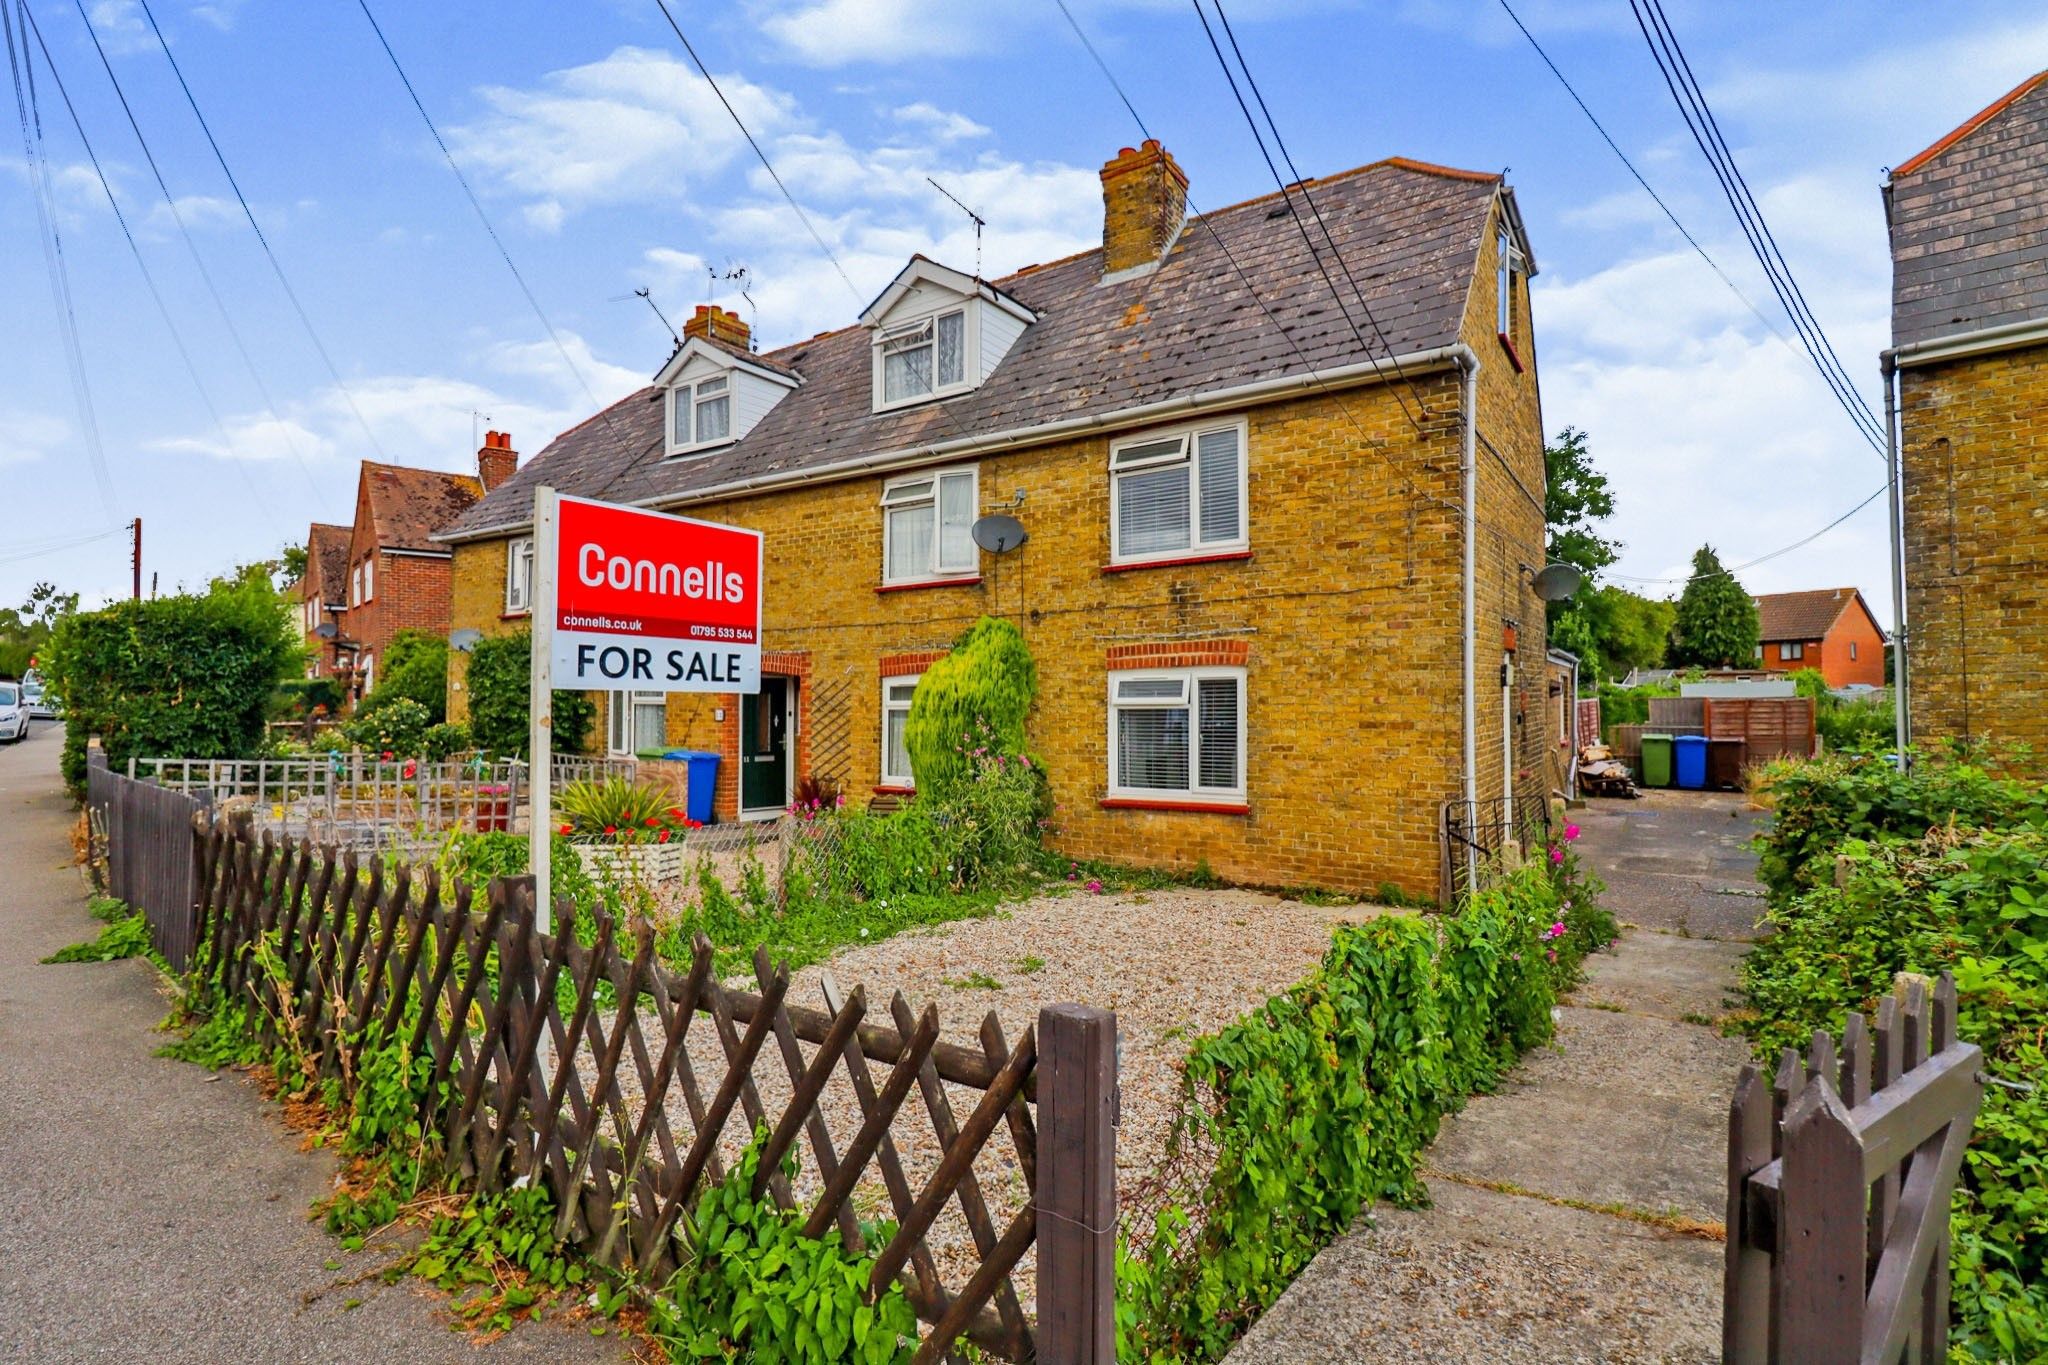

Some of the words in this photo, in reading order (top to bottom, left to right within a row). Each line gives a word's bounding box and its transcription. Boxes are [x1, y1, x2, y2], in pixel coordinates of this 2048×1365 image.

[578, 542, 744, 604] Connells
[563, 616, 643, 631] connells.co.uk
[690, 625, 716, 637] 01795
[717, 627, 735, 639] 533
[736, 629, 753, 640] 544
[577, 644, 654, 680] FOR
[666, 650, 741, 683] SALE
